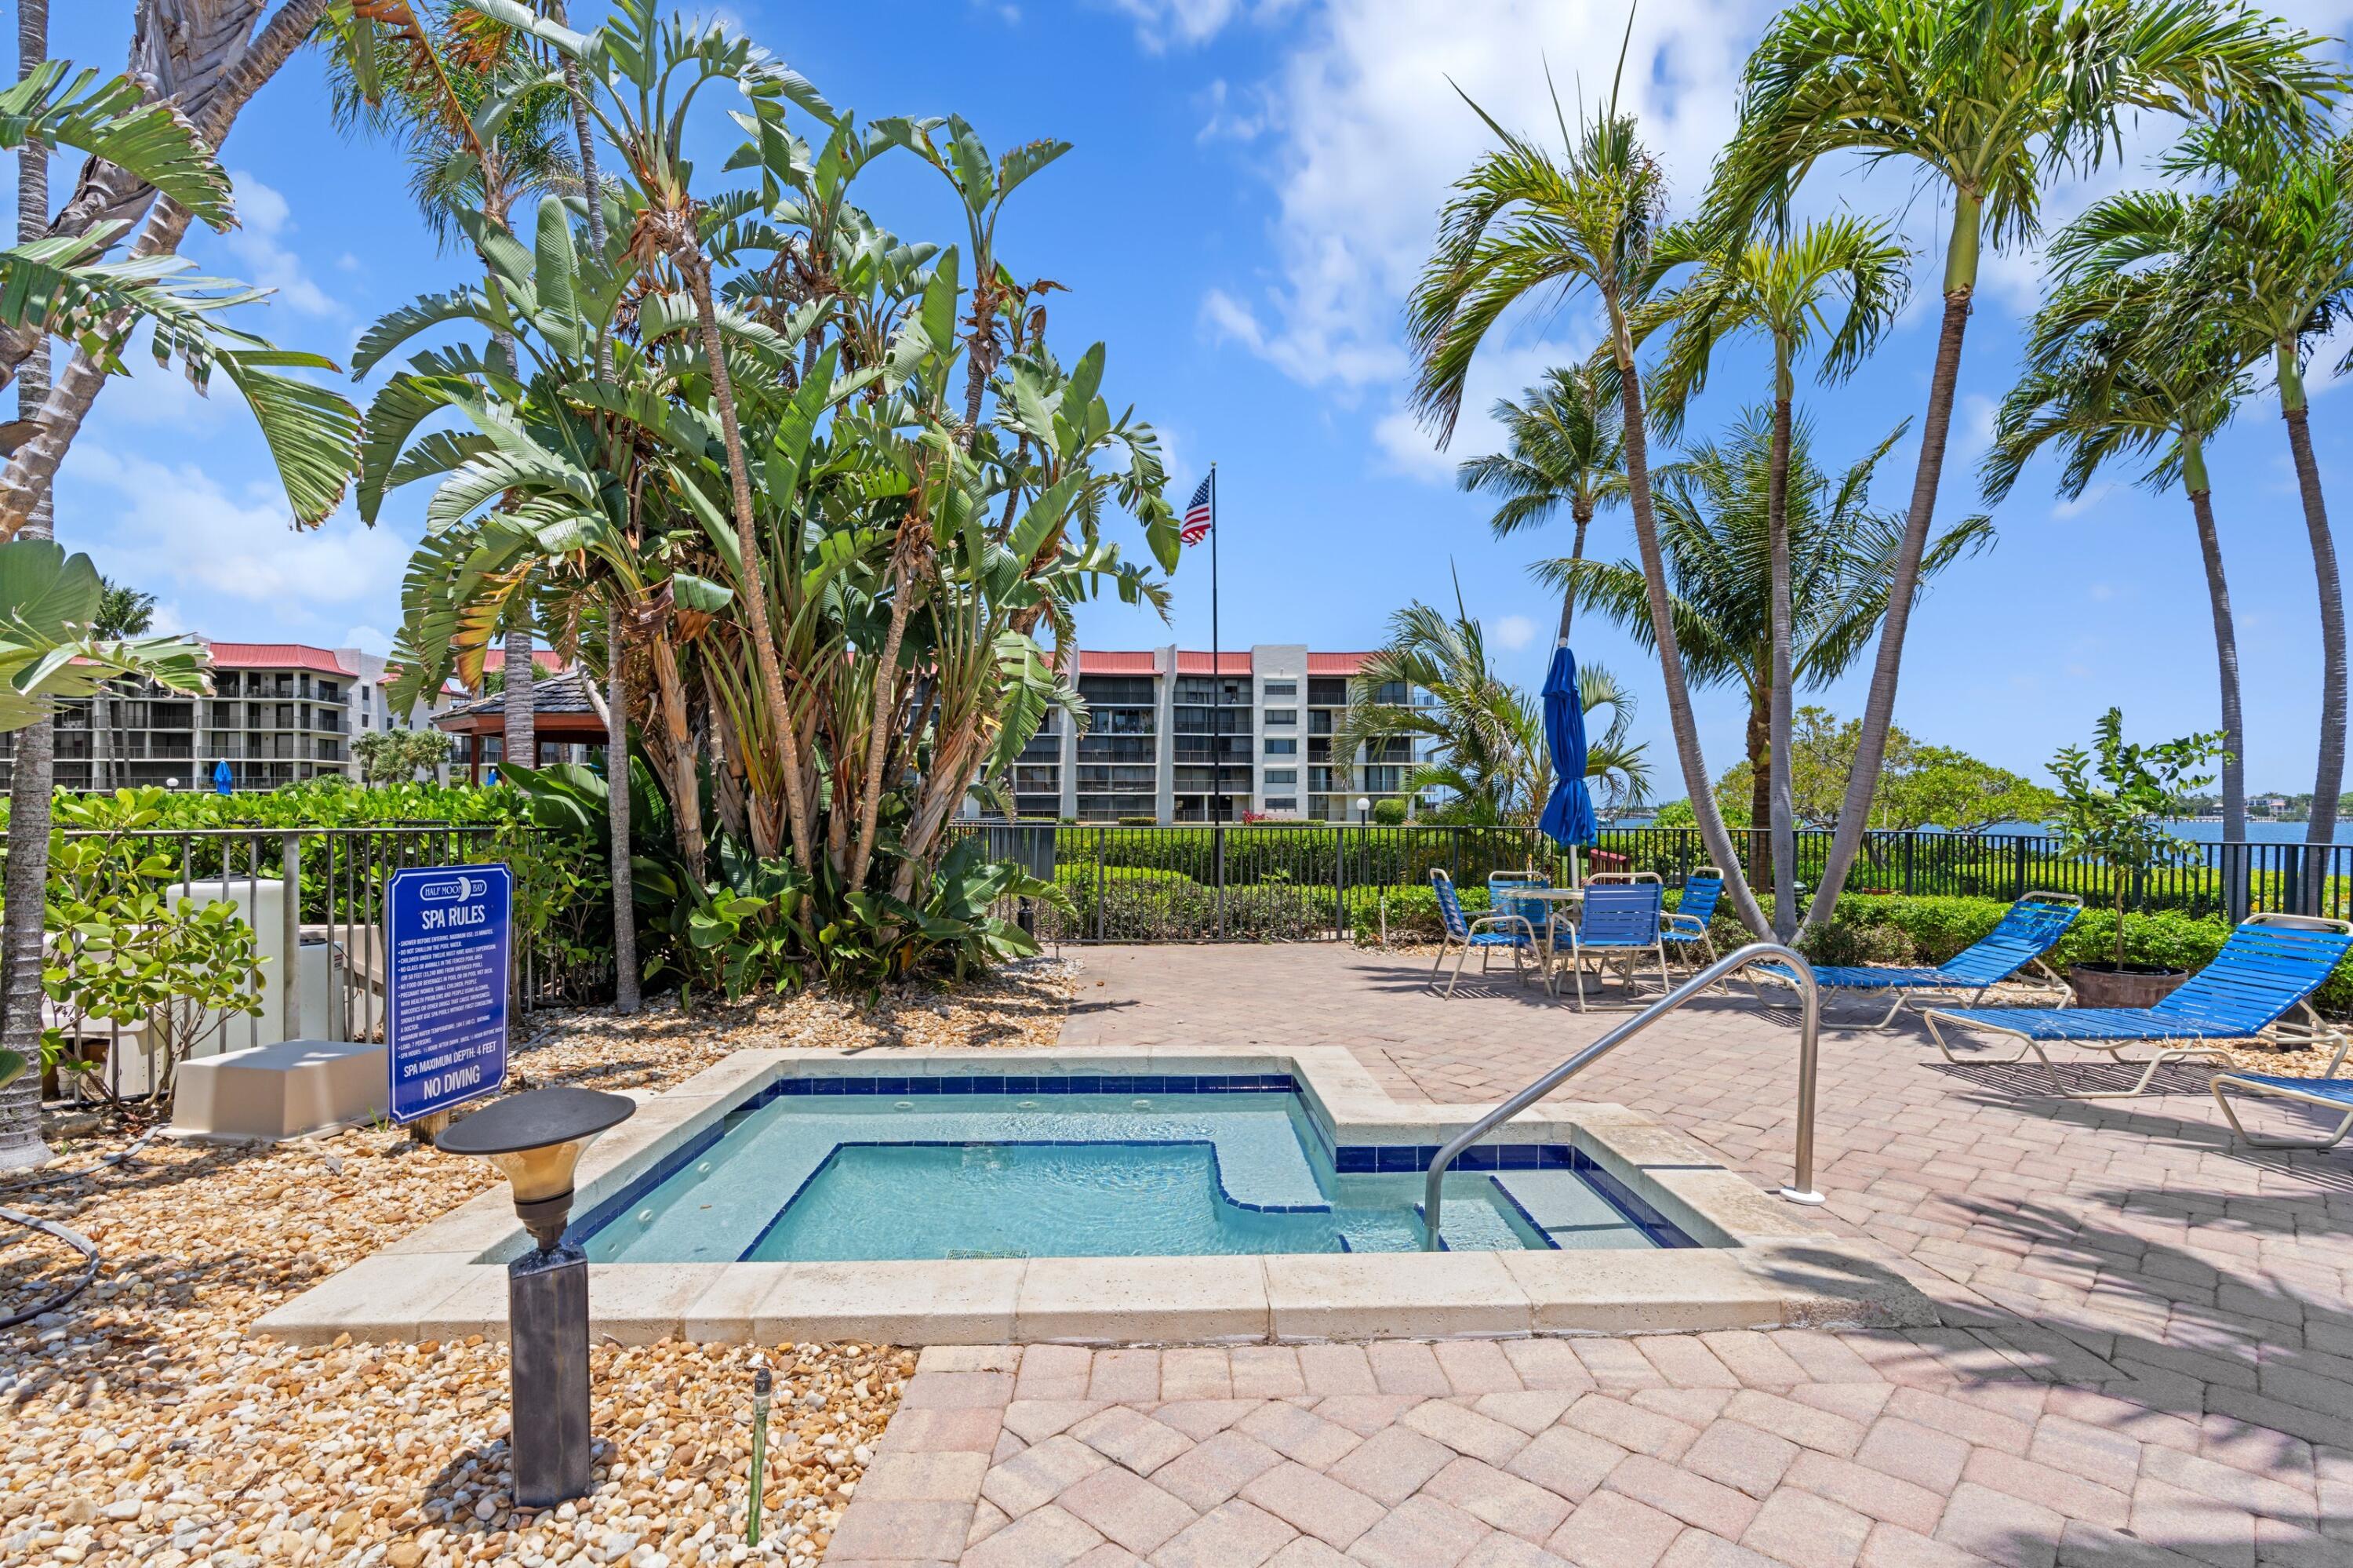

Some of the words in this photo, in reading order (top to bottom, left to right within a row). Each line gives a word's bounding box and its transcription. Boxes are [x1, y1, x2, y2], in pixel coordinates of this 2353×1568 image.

[424, 887, 440, 896] HALF
[442, 885, 461, 895] MOON
[472, 884, 484, 893] BAY
[422, 909, 446, 930] SPA
[449, 904, 485, 926] RULES
[415, 1038, 431, 1046] PERSONS
[404, 1064, 417, 1078] SPA
[420, 1054, 452, 1073] MAXIMUM
[453, 1048, 475, 1064] DEPTH:
[476, 1046, 482, 1056] 4
[482, 1042, 496, 1055] FEET
[424, 1077, 441, 1100] NO
[444, 1065, 479, 1093] DIVING
